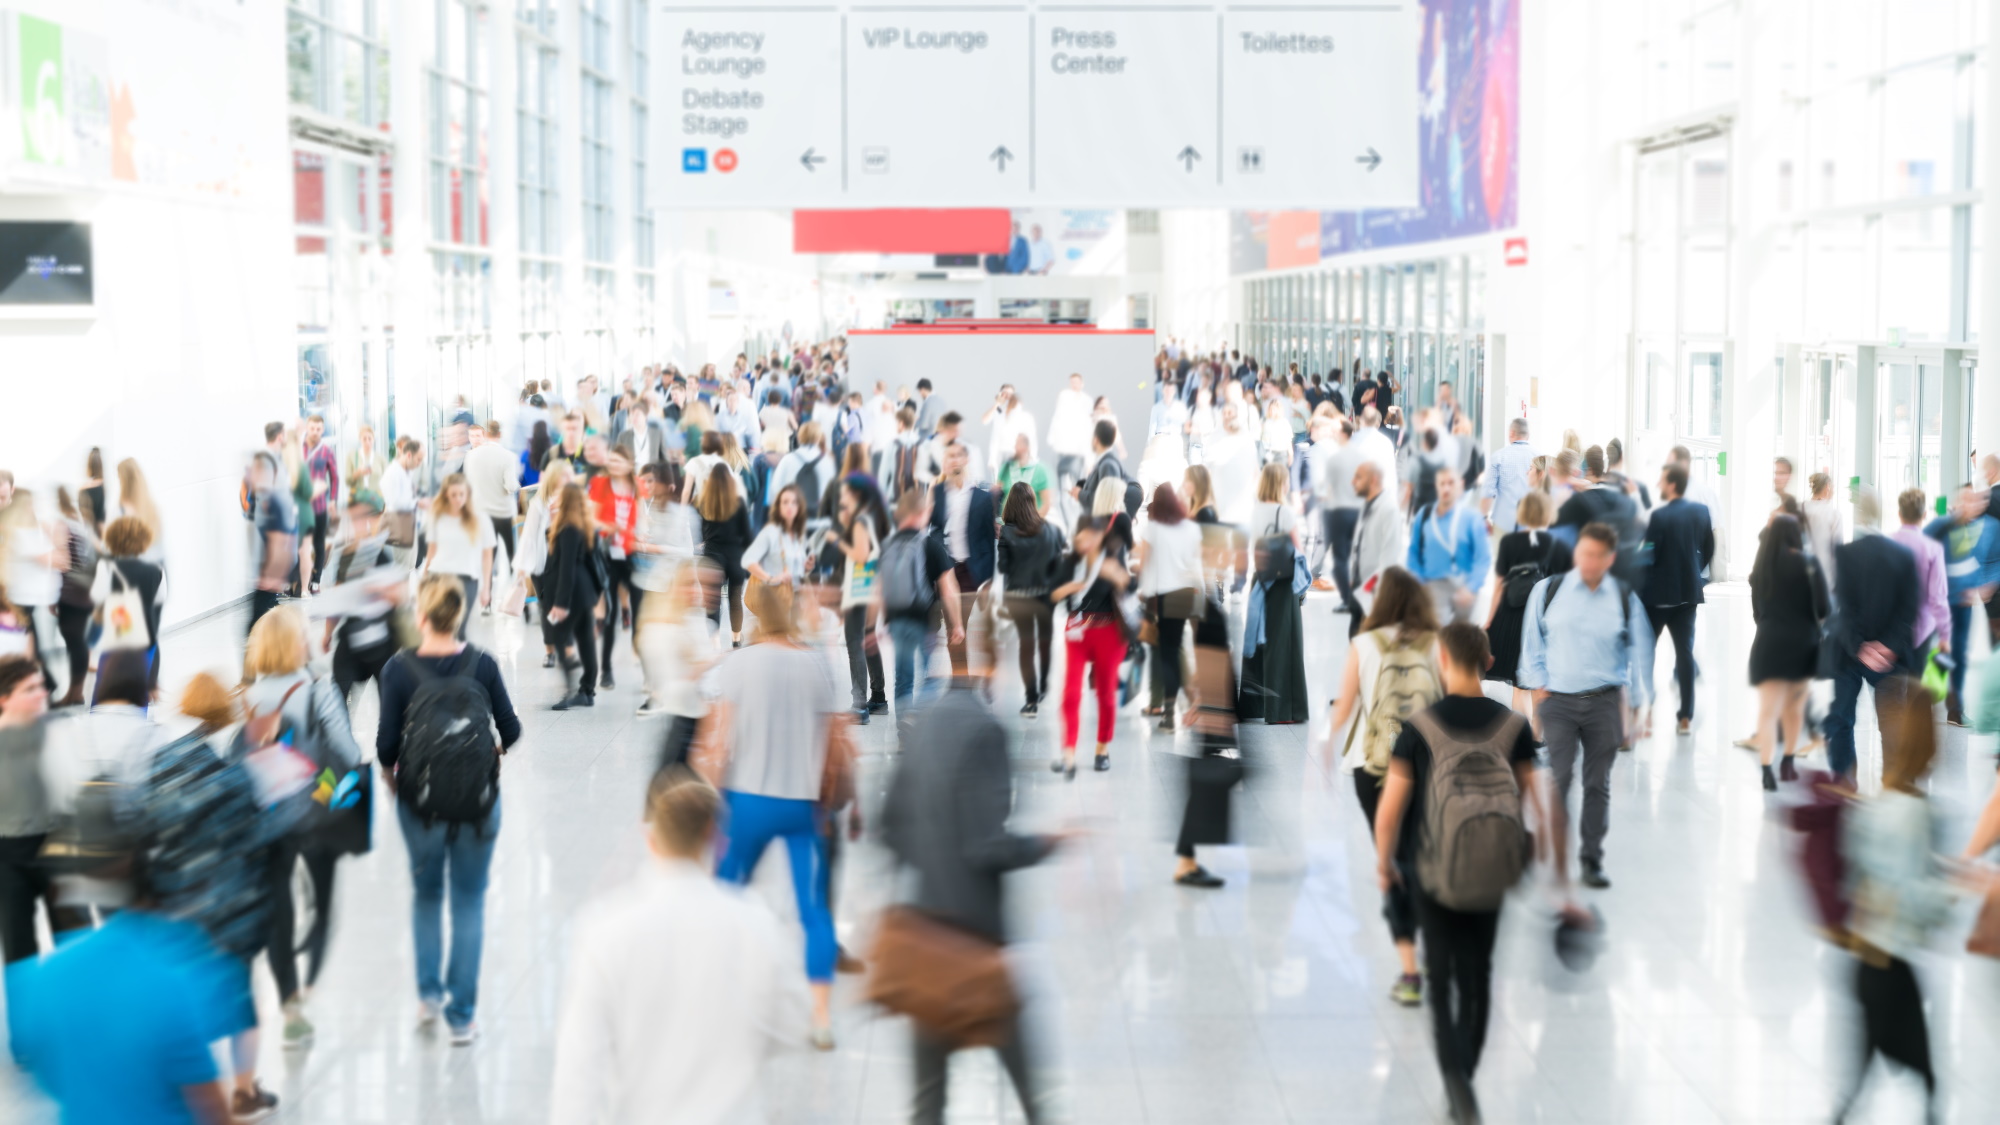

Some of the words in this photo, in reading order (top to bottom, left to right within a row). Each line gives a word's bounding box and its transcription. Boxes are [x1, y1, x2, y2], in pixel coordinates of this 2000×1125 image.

[681, 28, 765, 54] Agency
[862, 27, 900, 49] VIP
[903, 28, 989, 53] Lounge
[1050, 27, 1117, 49] Press
[1239, 31, 1335, 53] Toilettes
[681, 54, 767, 79] Lounge
[1050, 53, 1127, 75] Center
[682, 87, 765, 110] Debate
[682, 112, 749, 139] Stage
